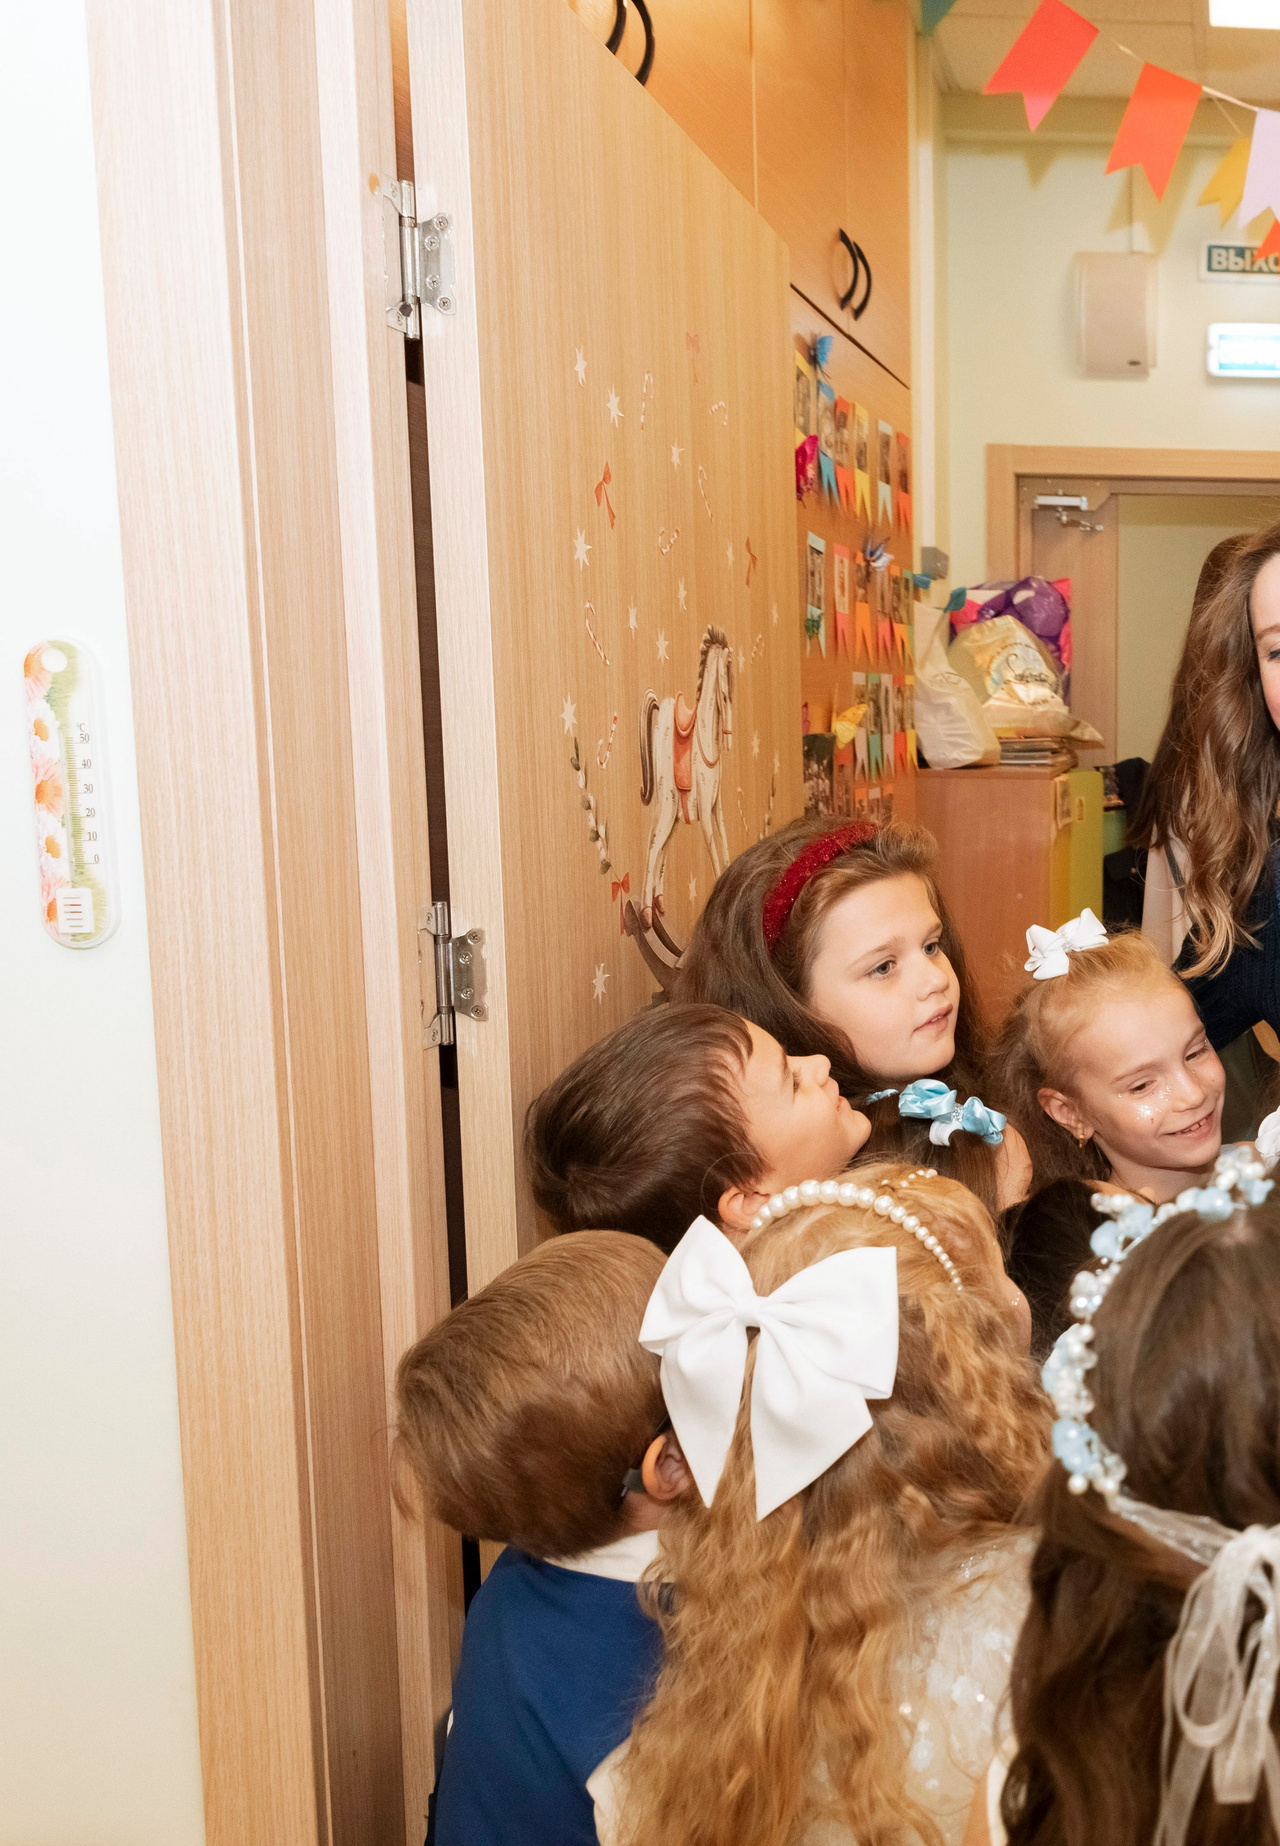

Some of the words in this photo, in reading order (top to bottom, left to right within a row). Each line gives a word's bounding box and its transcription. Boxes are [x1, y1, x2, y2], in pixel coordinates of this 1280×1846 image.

[79, 733, 90, 743] 50
[81, 758, 92, 769] 40
[83, 783, 94, 794] 30
[85, 807, 96, 818] 20
[87, 831, 98, 842] 10
[93, 854, 100, 864] 0
